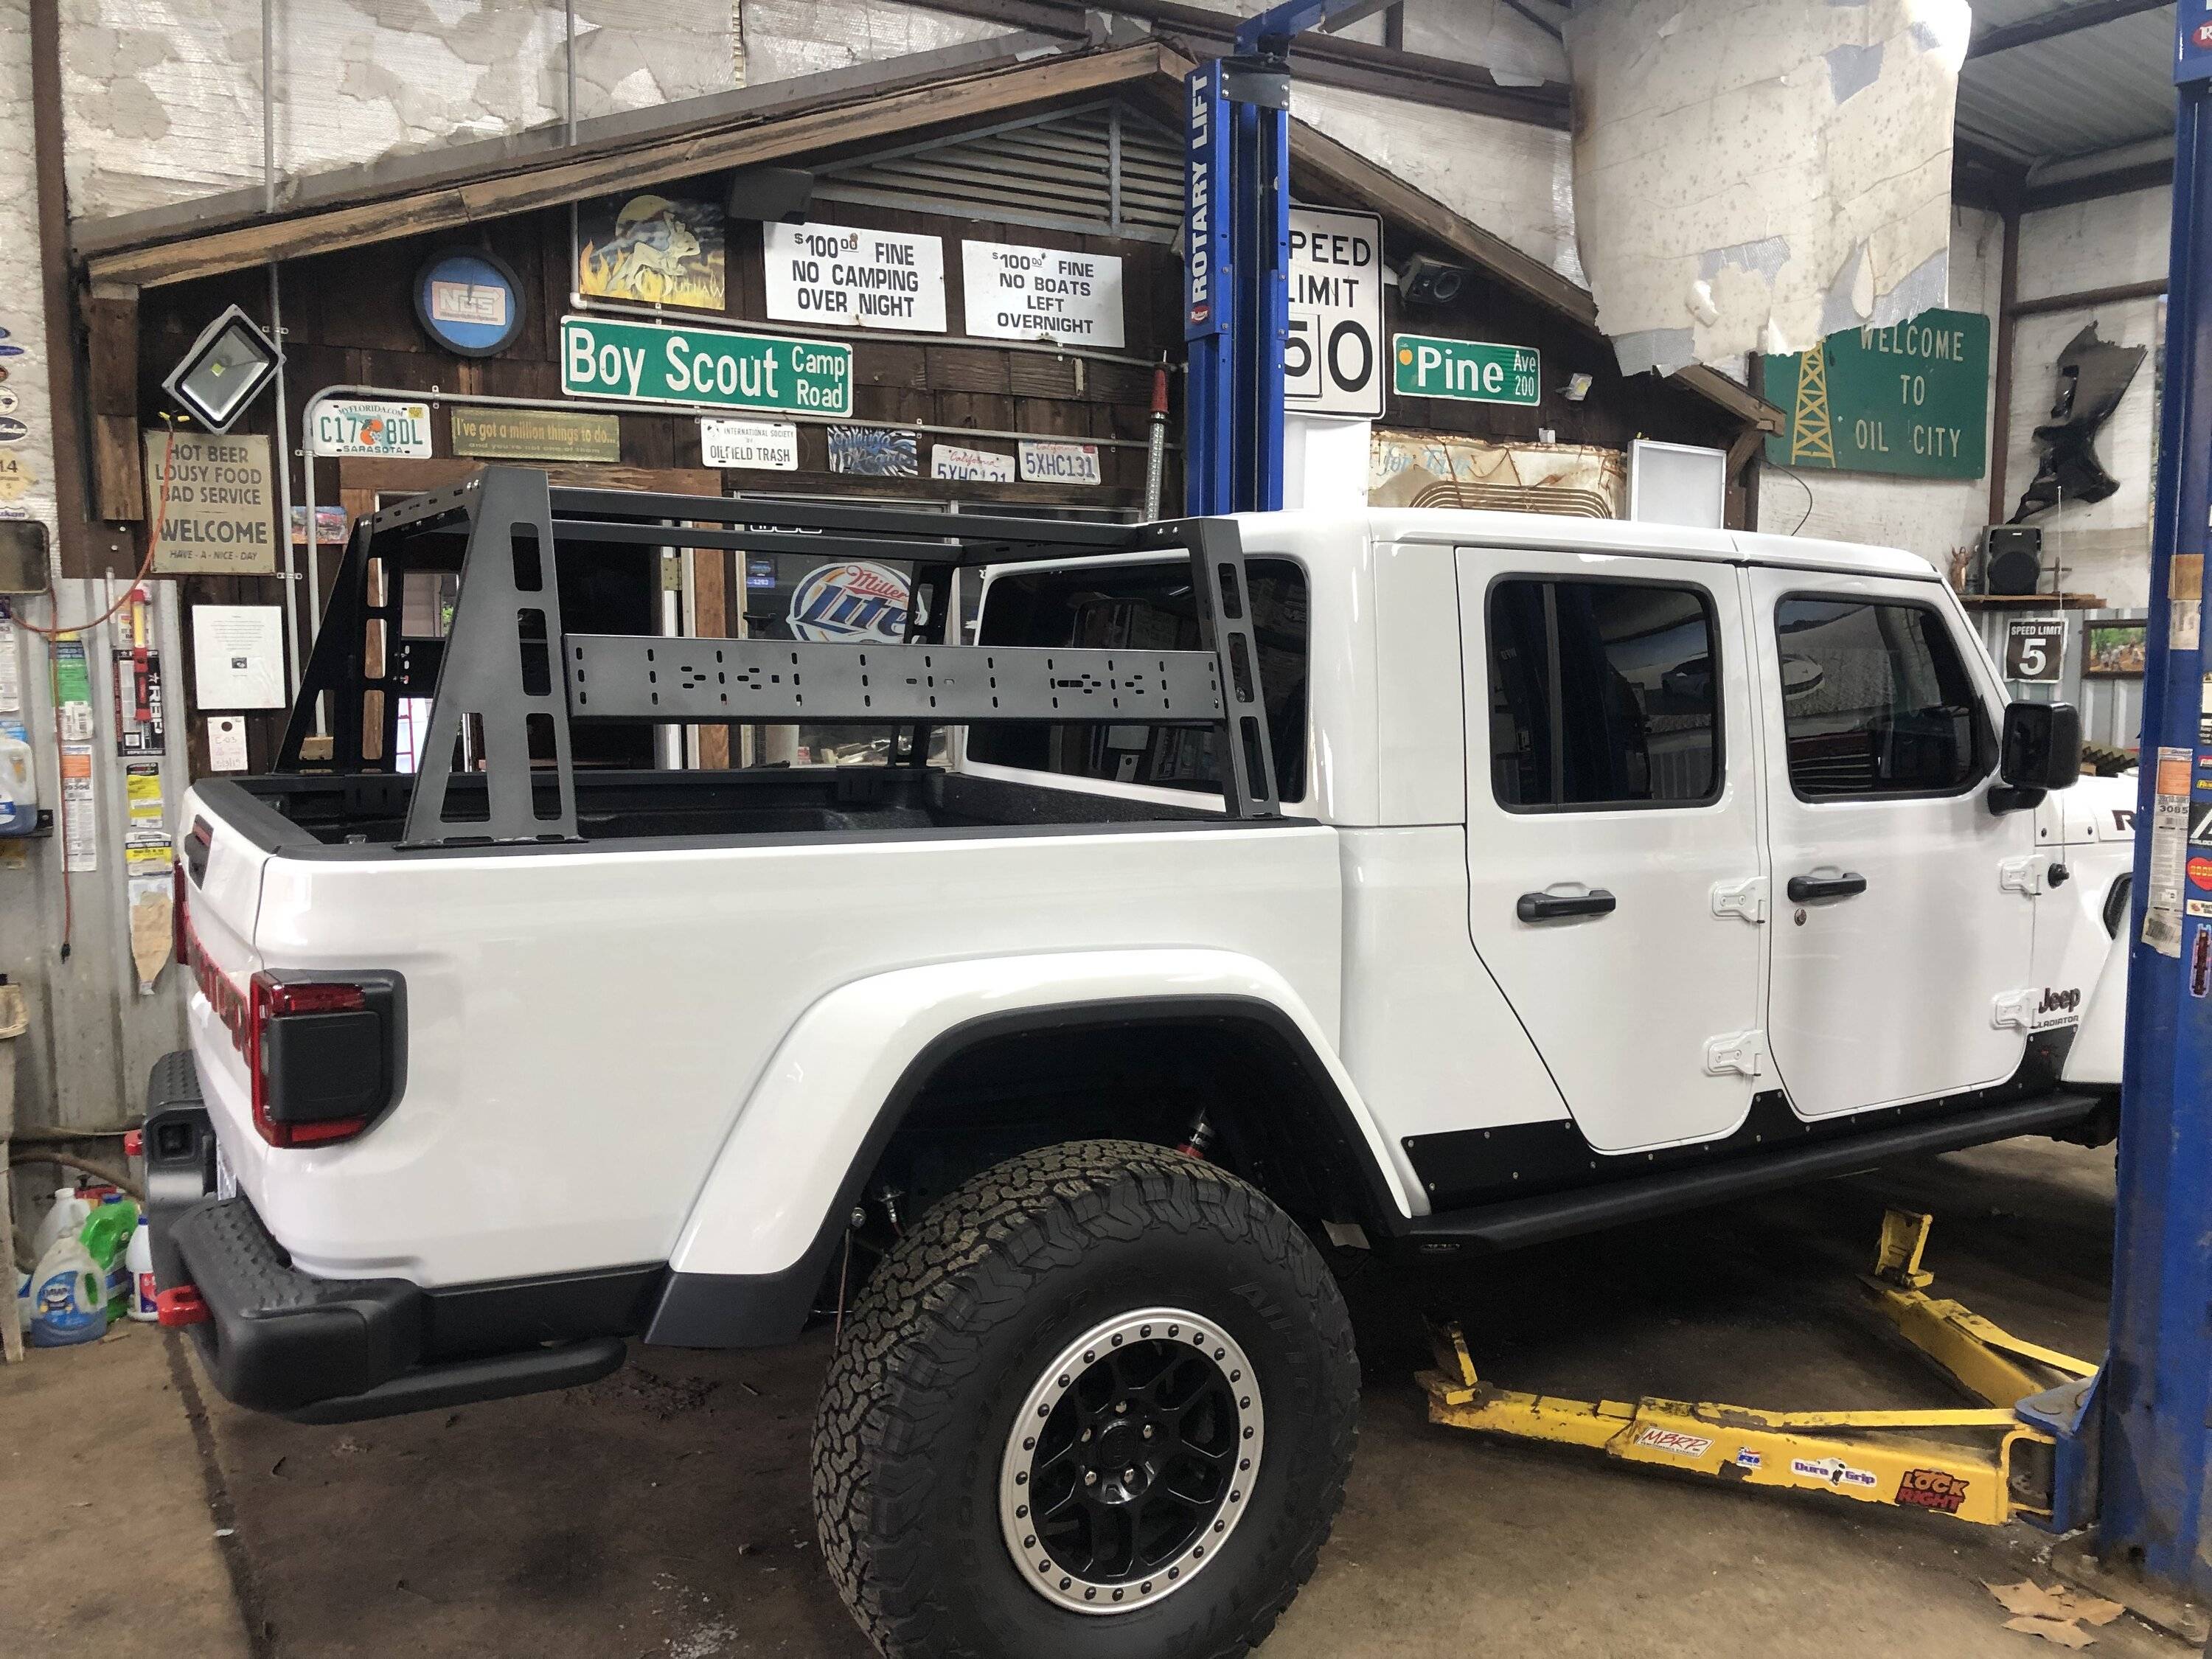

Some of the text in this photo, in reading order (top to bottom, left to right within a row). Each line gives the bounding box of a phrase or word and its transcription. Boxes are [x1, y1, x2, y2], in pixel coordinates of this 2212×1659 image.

[1192, 75, 1207, 149] LIFT
[1192, 161, 1207, 302] ROTARY
[875, 243, 914, 266] FINE
[1289, 230, 1371, 266] PEED
[793, 260, 918, 292] NO CAMPING
[1059, 260, 1094, 278] FINE
[1000, 273, 1091, 296] NO BOATS
[798, 288, 914, 318] OVER NIGHT
[1027, 296, 1064, 313] LEFT
[997, 313, 1093, 334] OVERNIGHT
[1284, 320, 1373, 392] 50
[1860, 324, 1964, 361] WELCOME
[569, 327, 778, 398] Boy Scout
[791, 346, 845, 383] Camp
[1418, 346, 1504, 394] Pine
[1513, 350, 1536, 373] Ave
[796, 379, 843, 408] Road
[1514, 375, 1534, 397] 200
[1900, 374, 1925, 406] TO
[321, 417, 423, 445] C17 8DL
[456, 418, 476, 437] I've
[479, 422, 496, 441] got
[499, 425, 507, 437] a
[509, 420, 545, 441] million
[547, 425, 579, 445] things
[581, 427, 591, 442] to
[723, 428, 794, 438] INTERNATIONAL SOCIETY
[1855, 419, 1961, 458] OIL CITY
[171, 444, 248, 463] HOT BEER
[343, 445, 403, 453] SARASOTA
[710, 445, 790, 462] OILFIELD TRASH
[155, 465, 262, 484] LOUSY FOOD
[1026, 452, 1095, 479] 5XHC131
[160, 485, 261, 505] BAD SERVICE
[161, 519, 268, 544] WELCOME
[170, 550, 192, 559] HAVE
[213, 552, 233, 560] NICE
[240, 552, 258, 561] DAY
[846, 565, 910, 599] Miller
[796, 583, 908, 637] Lite
[2011, 625, 2062, 636] SPEED LIMIT
[2019, 638, 2047, 675] 5
[2038, 987, 2081, 1015] Jeep
[1642, 1430, 1708, 1450] MBRP
[1795, 1461, 1875, 1484] Dura Grip
[1902, 1470, 1969, 1495] LOCK
